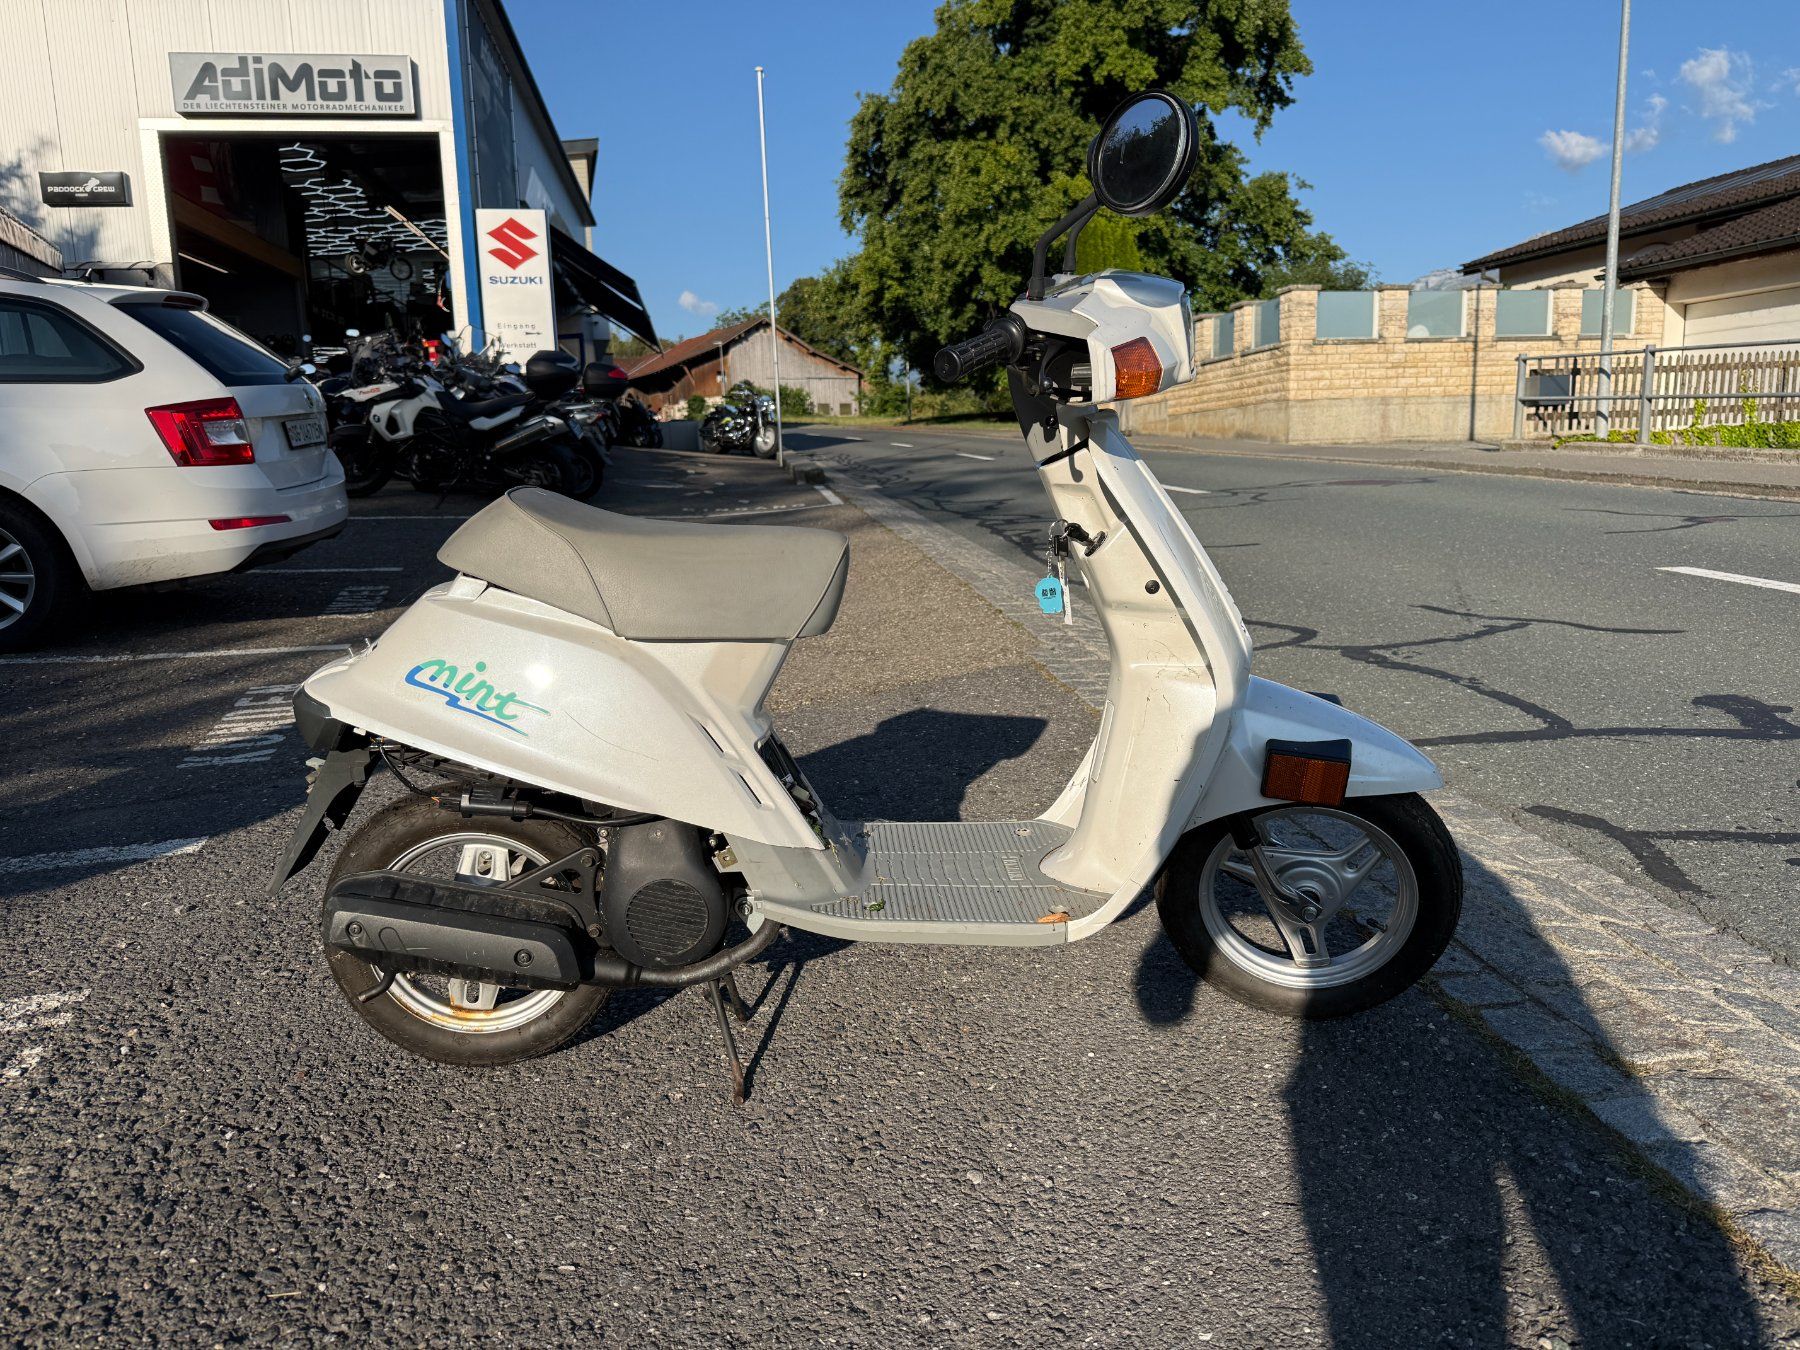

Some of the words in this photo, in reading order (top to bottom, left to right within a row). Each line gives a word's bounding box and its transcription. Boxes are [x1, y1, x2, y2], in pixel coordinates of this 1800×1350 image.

[184, 56, 403, 102] AdiMoto
[183, 102, 201, 110] DER
[205, 102, 288, 111] LIECHTENSTEINER
[291, 103, 405, 112] MOTORRADMECHANIKER
[489, 276, 543, 285] SUZUKI
[497, 322, 537, 331] Eingang
[405, 659, 550, 720] mint
